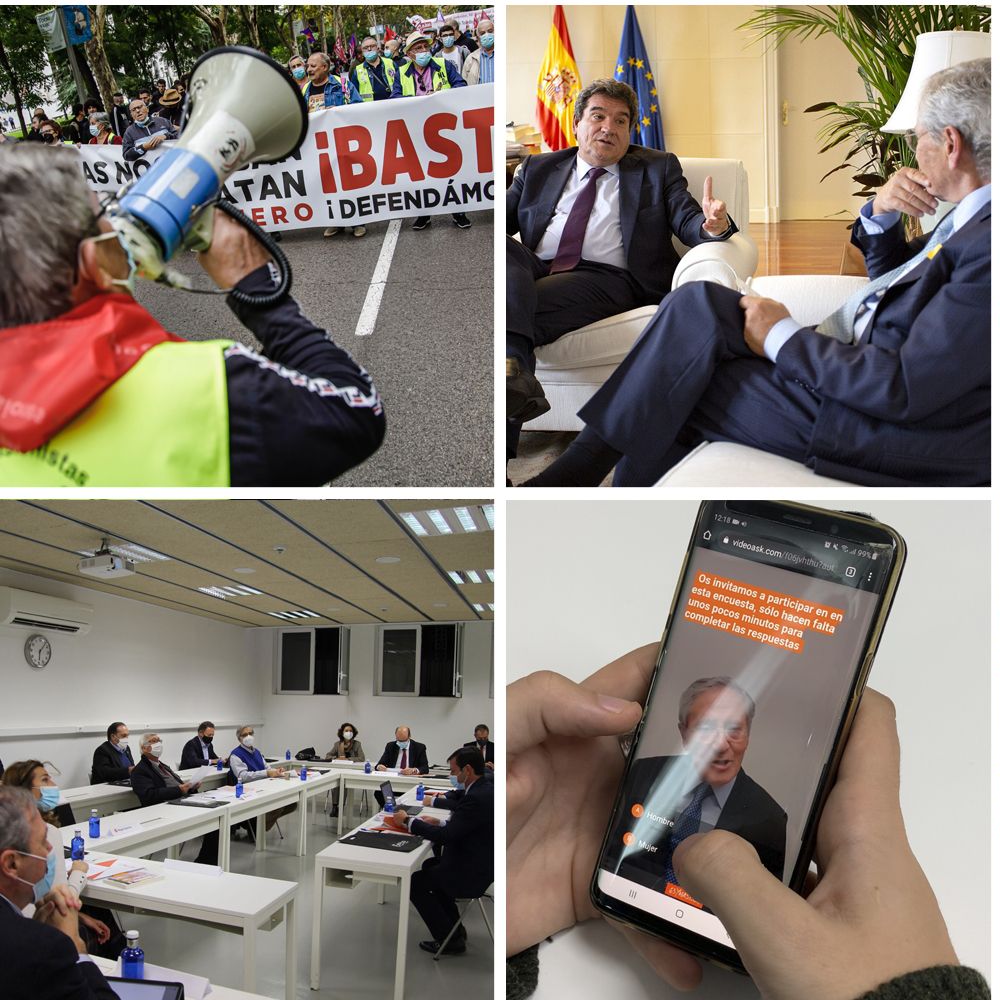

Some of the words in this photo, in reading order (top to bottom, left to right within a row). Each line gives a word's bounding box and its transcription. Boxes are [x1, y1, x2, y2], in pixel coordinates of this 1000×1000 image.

[240, 202, 313, 226] ERO
[714, 513, 731, 525] 12:18
[691, 586, 711, 598] esta
[713, 593, 756, 613] encuesta,
[759, 604, 779, 617] sólo
[781, 610, 810, 626] hacen
[812, 619, 835, 634] falta
[698, 574, 711, 585] Os
[713, 577, 758, 598] invitamos
[759, 592, 766, 600] a
[767, 594, 815, 613] participar
[815, 608, 828, 617] en
[830, 613, 843, 622] en
[684, 610, 730, 630] completar
[731, 622, 746, 634] las
[747, 629, 800, 650] respuestas
[688, 598, 710, 611] unos
[711, 605, 740, 620] pocos
[741, 613, 779, 631] minutos
[781, 626, 803, 638] para
[646, 811, 674, 828] Hombre
[638, 840, 658, 853] Mujer
